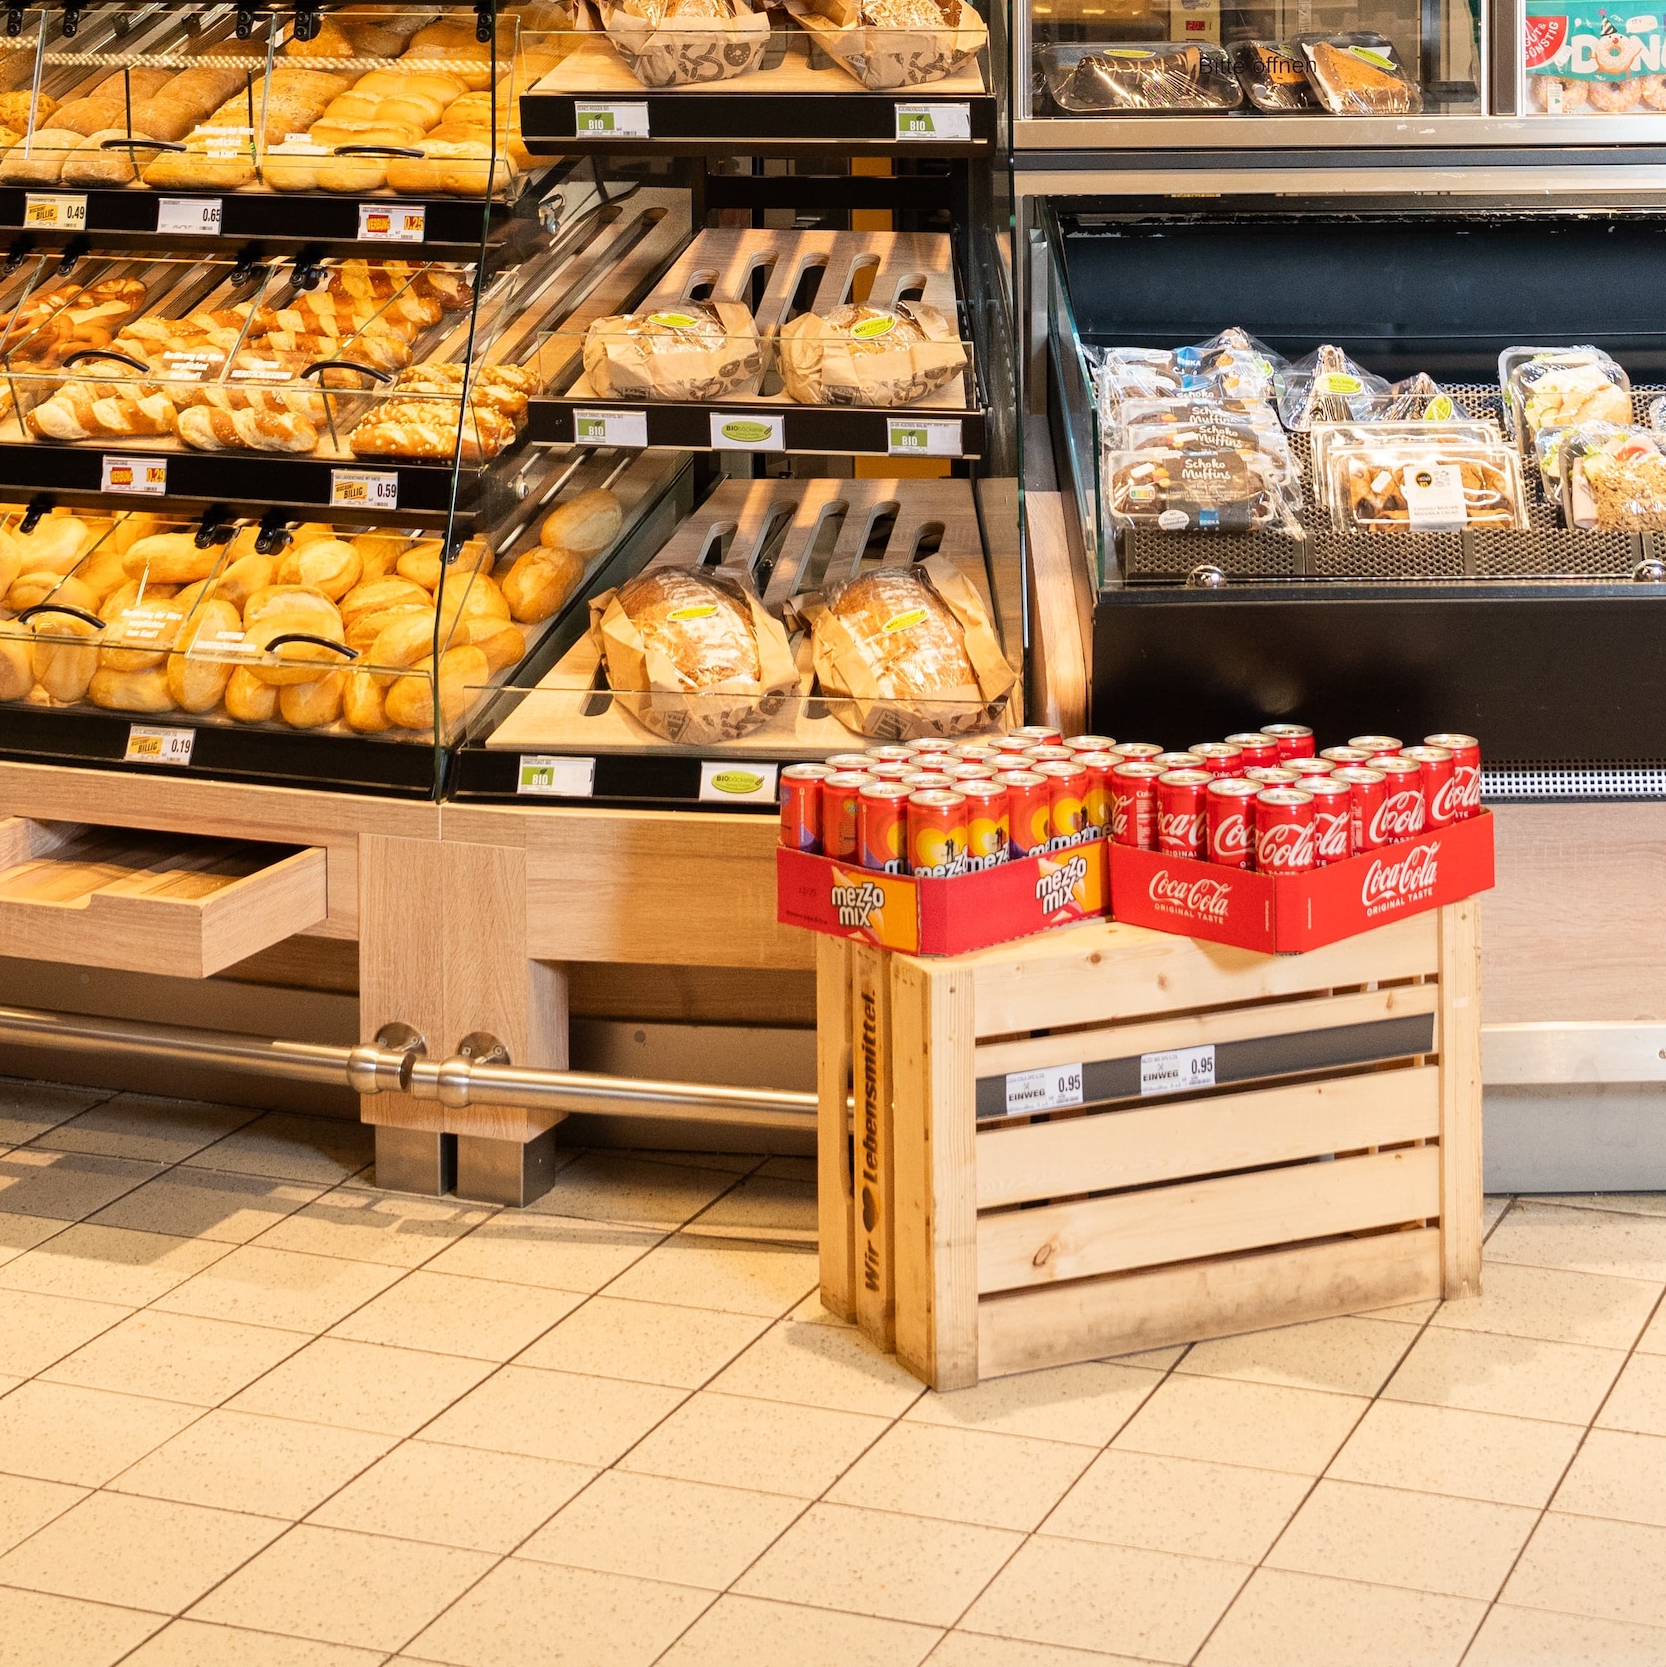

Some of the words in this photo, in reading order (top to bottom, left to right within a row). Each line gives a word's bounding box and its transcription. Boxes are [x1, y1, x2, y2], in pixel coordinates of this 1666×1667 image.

[1199, 57, 1242, 74] Bitte
[1253, 55, 1317, 74] öffnen
[589, 120, 604, 130] BIO
[909, 120, 926, 131] BIO
[66, 204, 85, 220] 0.49
[202, 207, 221, 222] 0.65
[404, 216, 424, 231] 0.25
[588, 425, 603, 437] BIO
[1199, 425, 1239, 437] Schoko
[902, 435, 918, 446] BIO
[1196, 433, 1243, 448] Muffins
[1184, 458, 1226, 469] Schoko
[146, 466, 165, 482] 0.29
[1181, 468, 1232, 480] Muffins
[342, 486, 364, 500] BILLIG
[377, 483, 396, 498] 0.59
[138, 741, 158, 754] BILLIG
[171, 740, 191, 753] 0.19
[533, 773, 548, 785] BIO
[1035, 854, 1088, 900] mezzo
[1360, 840, 1441, 909] Coca-Cola
[831, 881, 886, 912] mezzo
[1148, 868, 1233, 915] Coca-Cola
[1042, 883, 1076, 916] mix
[1366, 897, 1406, 918] ORIGINAL
[1407, 889, 1434, 906] TASTE
[839, 903, 875, 928] mix
[1154, 901, 1195, 918] ORIGINAL
[1197, 911, 1225, 925] TASTE
[1143, 1069, 1179, 1082] EINWEG
[1191, 1057, 1213, 1074] 0.95
[861, 989, 876, 1184] Lebensmittel.
[1008, 1089, 1046, 1102] EINWEG
[1058, 1075, 1081, 1093] 0.95
[864, 1238, 881, 1292] Wir
